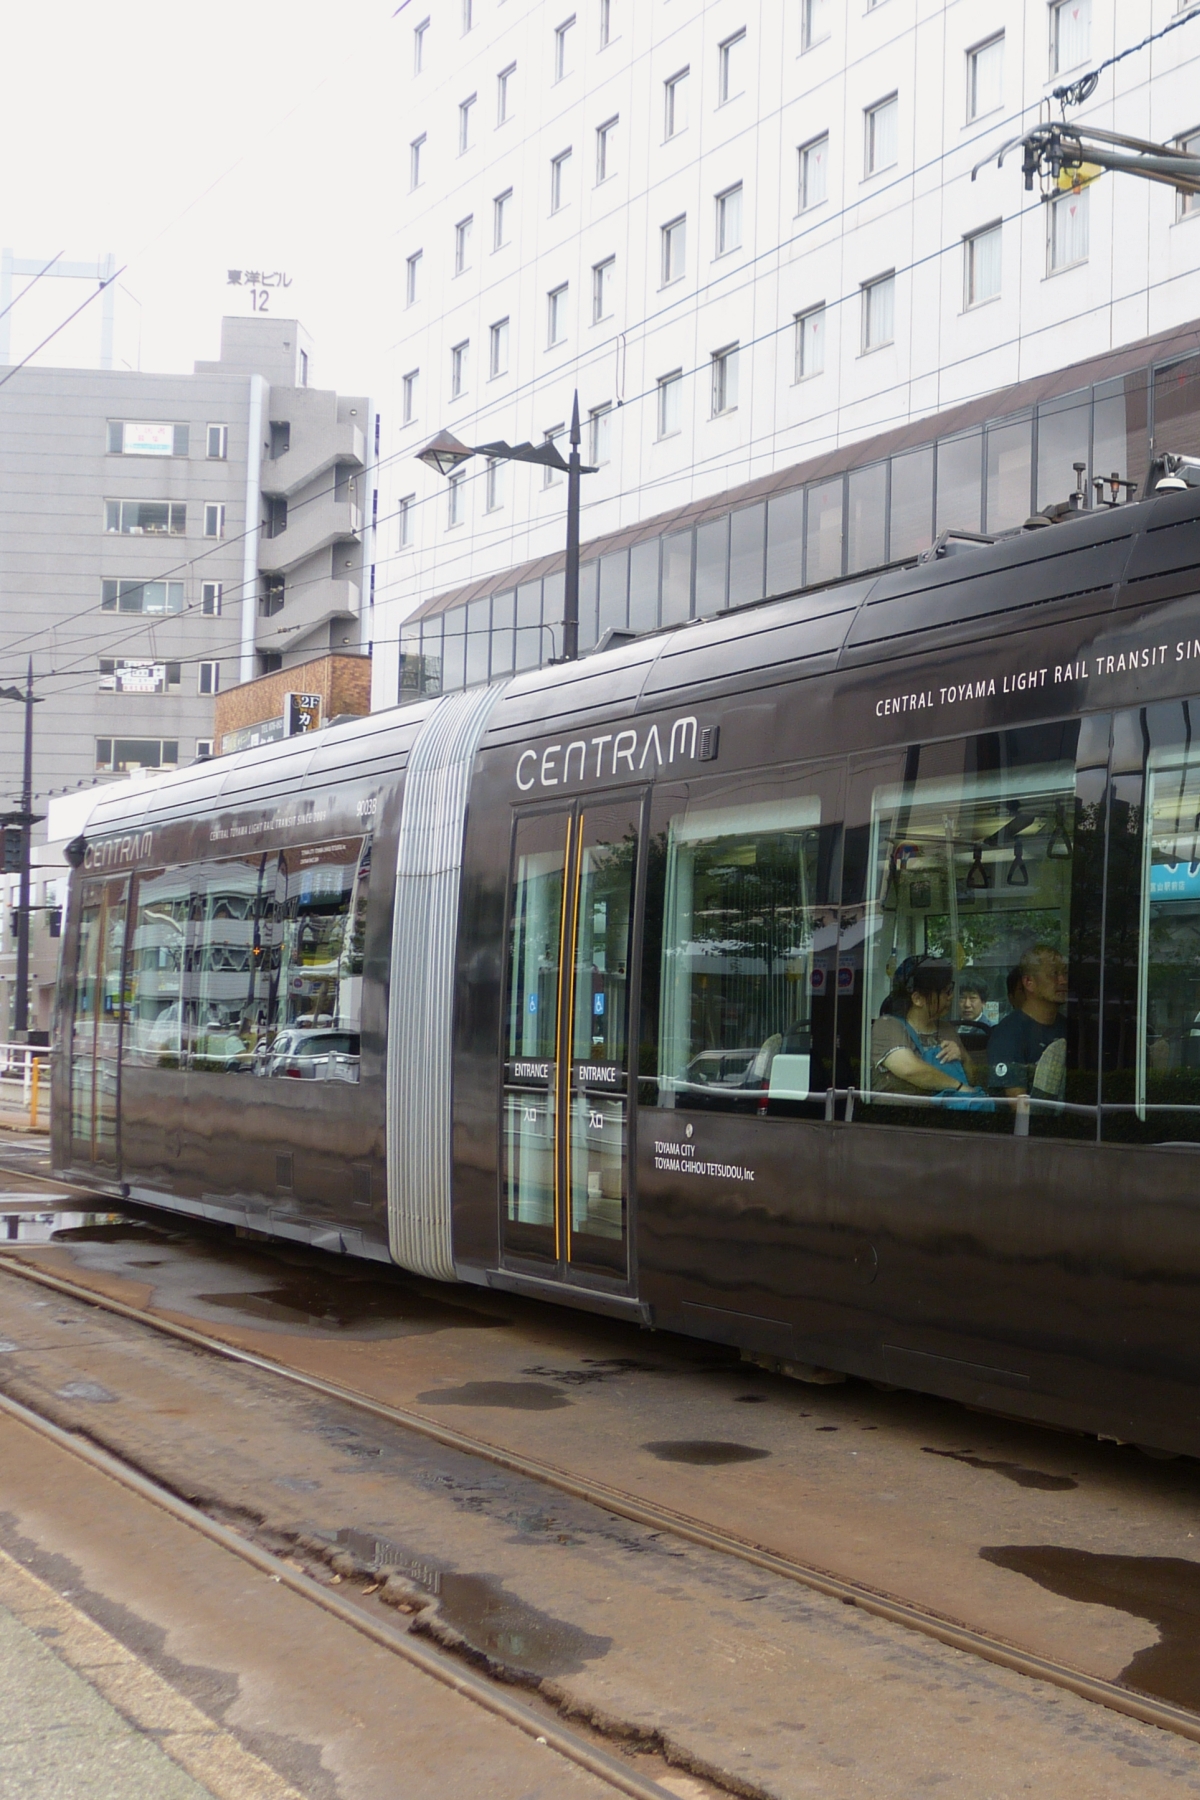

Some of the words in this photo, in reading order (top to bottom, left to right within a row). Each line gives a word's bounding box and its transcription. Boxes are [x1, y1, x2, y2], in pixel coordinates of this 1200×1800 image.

[226, 269, 293, 288] 東洋ビル
[250, 288, 269, 312] 12
[875, 692, 934, 717] CENTRAL
[939, 678, 996, 705] TOYAMA
[1002, 668, 1048, 694] LIGHT
[1054, 660, 1089, 684] RAIL
[1097, 645, 1168, 675] TRANSIT
[301, 696, 320, 708] 2F
[516, 716, 698, 791] CENTRAM
[356, 798, 377, 817] 9003B
[210, 829, 229, 841] CENTRAL
[229, 825, 248, 838] TOYAMA
[248, 822, 263, 834] LIGHT
[263, 820, 274, 831] RAIL
[275, 815, 296, 829] TRANSIT
[297, 812, 312, 826] SINCE
[84, 831, 153, 870] CENTRAM
[514, 1063, 549, 1078] ENTRANCE
[579, 1066, 616, 1082] ENTRANCE
[524, 1107, 537, 1122] 入口
[589, 1110, 603, 1128] 入口
[655, 1141, 680, 1156] TOYAMA
[681, 1144, 695, 1157] CITY
[655, 1157, 680, 1171] TOYAMA
[681, 1160, 706, 1175] CHIHOU
[744, 1167, 755, 1180] Inc
